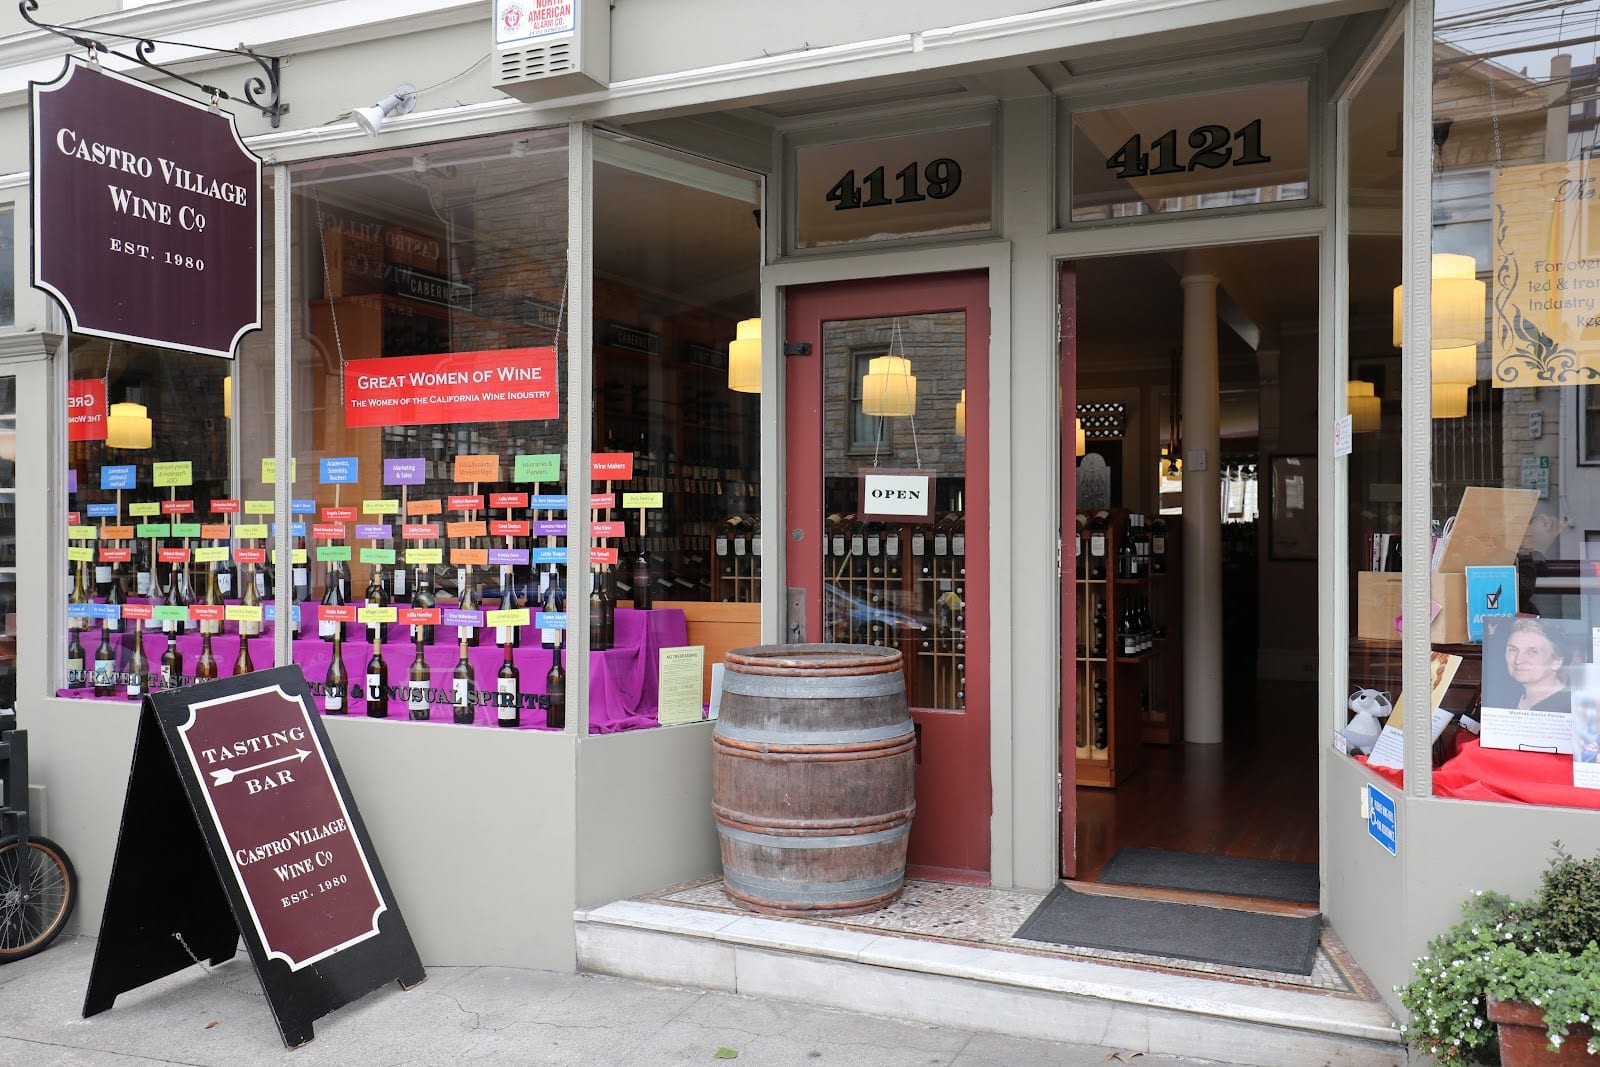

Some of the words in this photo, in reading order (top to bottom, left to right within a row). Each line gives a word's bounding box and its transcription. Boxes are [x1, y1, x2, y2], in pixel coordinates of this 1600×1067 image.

[528, 4, 571, 22] AMERICAN
[534, 20, 553, 30] ALARM
[1106, 118, 1272, 180] 4121
[56, 127, 153, 179] CASTRO
[158, 157, 248, 207] VILLAGE
[825, 157, 963, 211] 4119
[1553, 177, 1597, 202] The
[108, 184, 172, 226] WINE
[110, 238, 155, 260] EST.
[164, 251, 205, 272] 1980
[1534, 261, 1562, 273] For
[1556, 277, 1569, 291] &
[1529, 296, 1594, 311] Industry
[357, 375, 405, 390] GREAT
[409, 371, 469, 387] WOMEN
[472, 370, 493, 383] OF
[496, 367, 542, 381] WINE
[351, 399, 367, 408] THE
[368, 398, 399, 407] WOMEN
[400, 397, 411, 405] OF
[412, 397, 428, 405] THE
[429, 394, 480, 404] CALIFORNIA
[482, 392, 505, 401] WINE
[507, 390, 551, 400] INDUSTRY
[871, 489, 921, 500] OPEN
[66, 669, 142, 687] CURATED
[350, 683, 364, 699] &
[368, 684, 463, 705] UNUSUAL
[467, 690, 552, 710] SPIRITS
[201, 726, 306, 764] TASTING
[244, 769, 296, 796] BAR
[235, 835, 293, 867] CASTRO
[291, 818, 347, 848] VILLAGE
[273, 858, 315, 883] WINE
[280, 888, 315, 909] EST.
[318, 874, 349, 893] 1980
